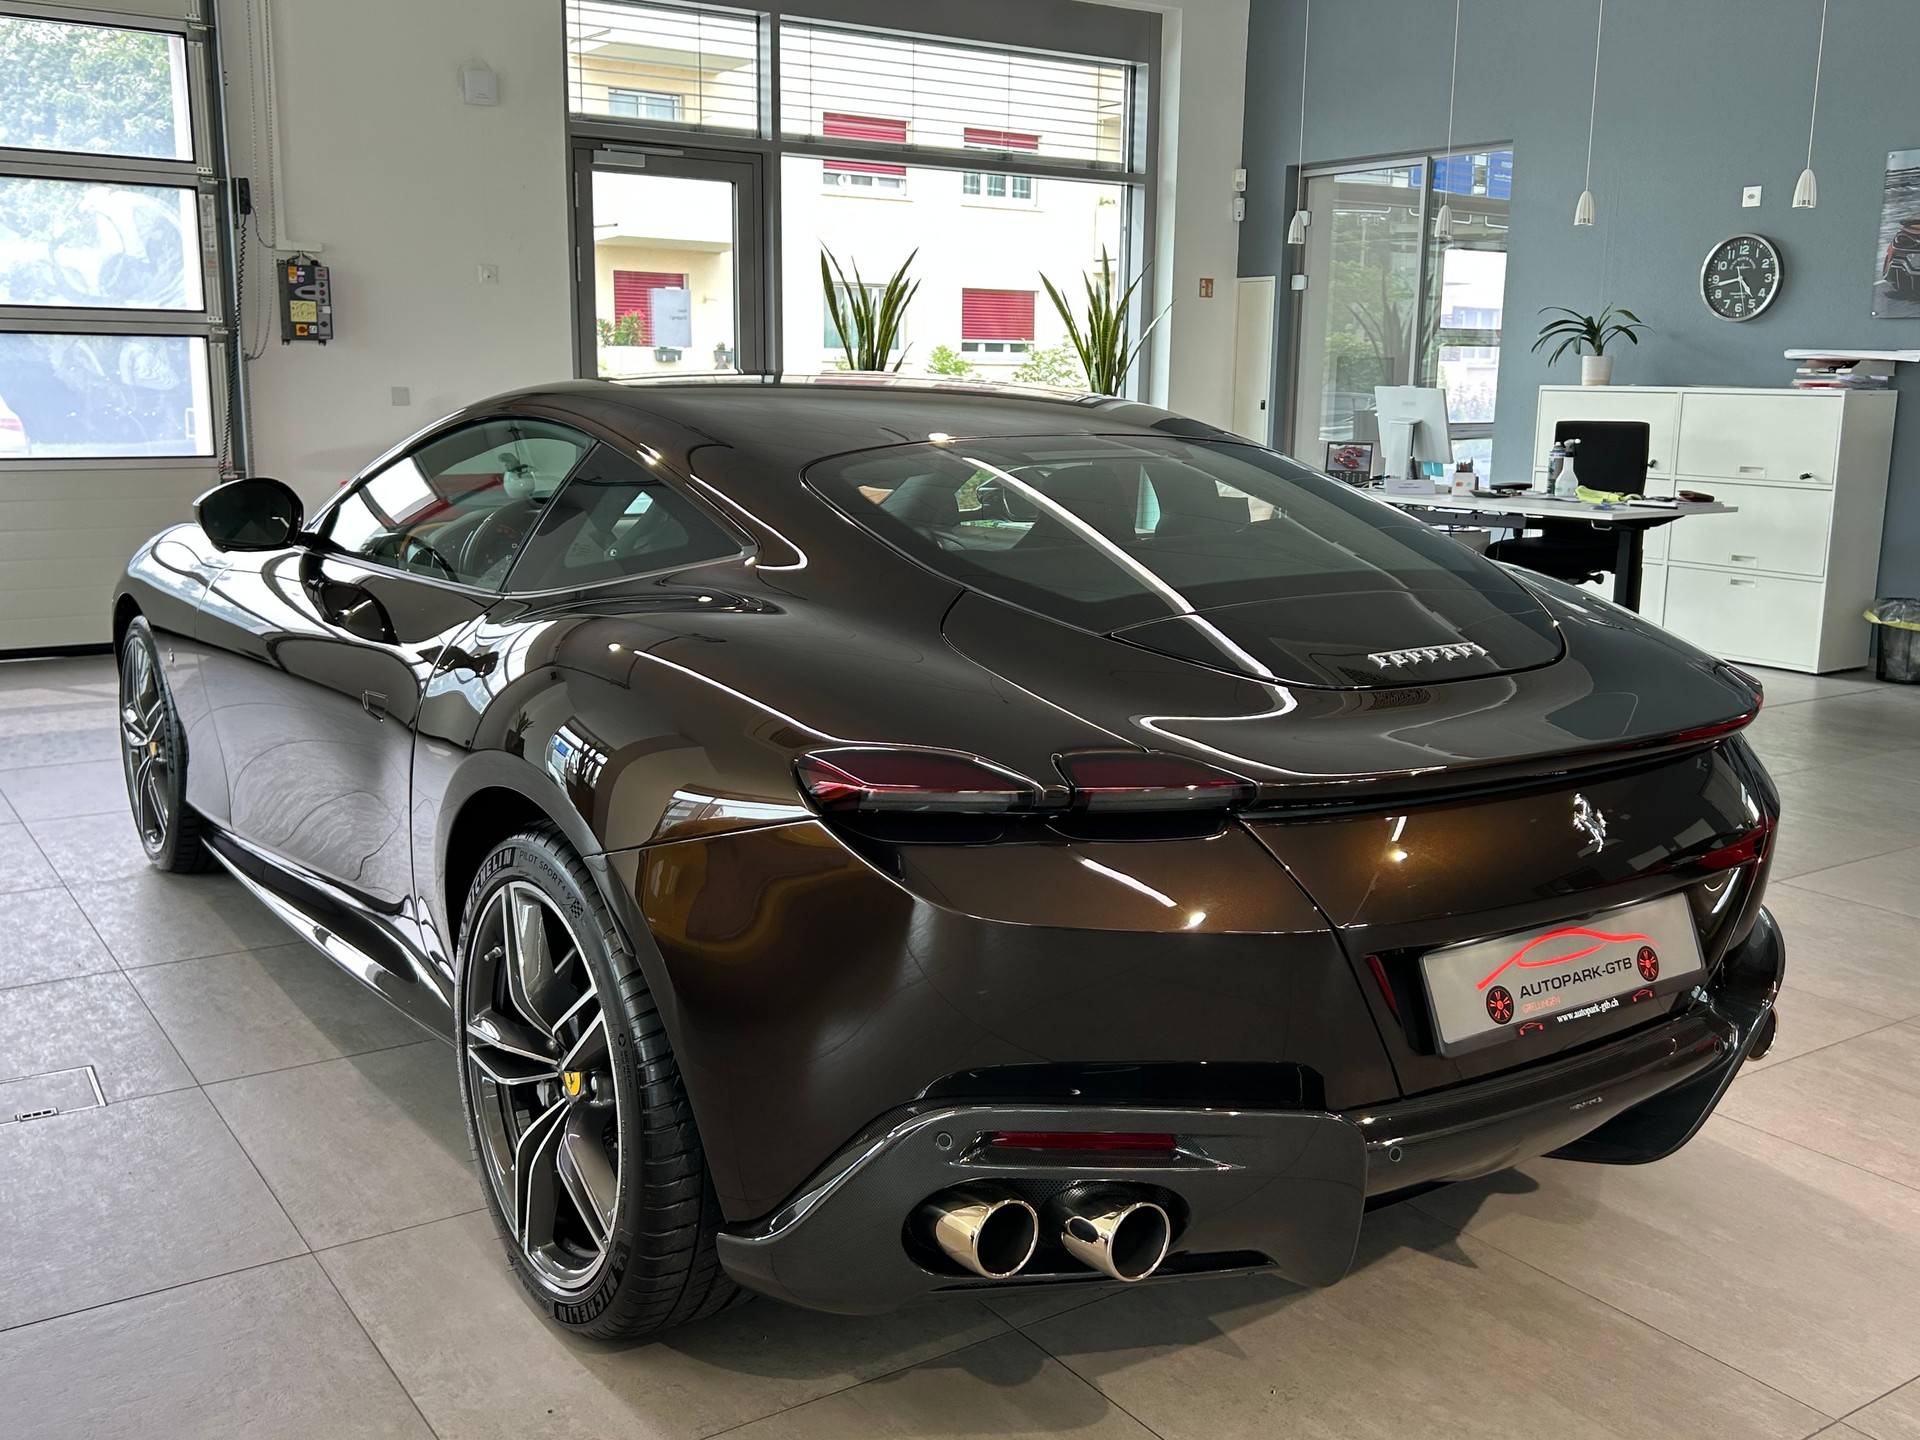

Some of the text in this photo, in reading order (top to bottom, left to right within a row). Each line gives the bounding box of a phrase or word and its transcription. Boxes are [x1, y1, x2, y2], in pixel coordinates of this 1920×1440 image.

[1728, 249, 1736, 259] 11
[1739, 245, 1750, 255] 12
[1756, 248, 1760, 258] 1
[1717, 261, 1728, 271] 10
[1761, 258, 1770, 269] 2
[1712, 275, 1720, 284] 9
[1764, 273, 1773, 283] 3
[1714, 289, 1722, 299] 8
[1757, 288, 1766, 298] 4
[1723, 299, 1731, 309] 7
[1734, 303, 1743, 313] 6
[1747, 299, 1756, 309] 5
[1367, 641, 1489, 670] Ferrari
[519, 850, 538, 865] PILOT
[538, 861, 563, 887] SPORT
[1520, 957, 1633, 999] AUTOPARK-GTB
[1556, 997, 1620, 1023] www.autopark-gtb.ch
[557, 1268, 619, 1323] MICHELIN
